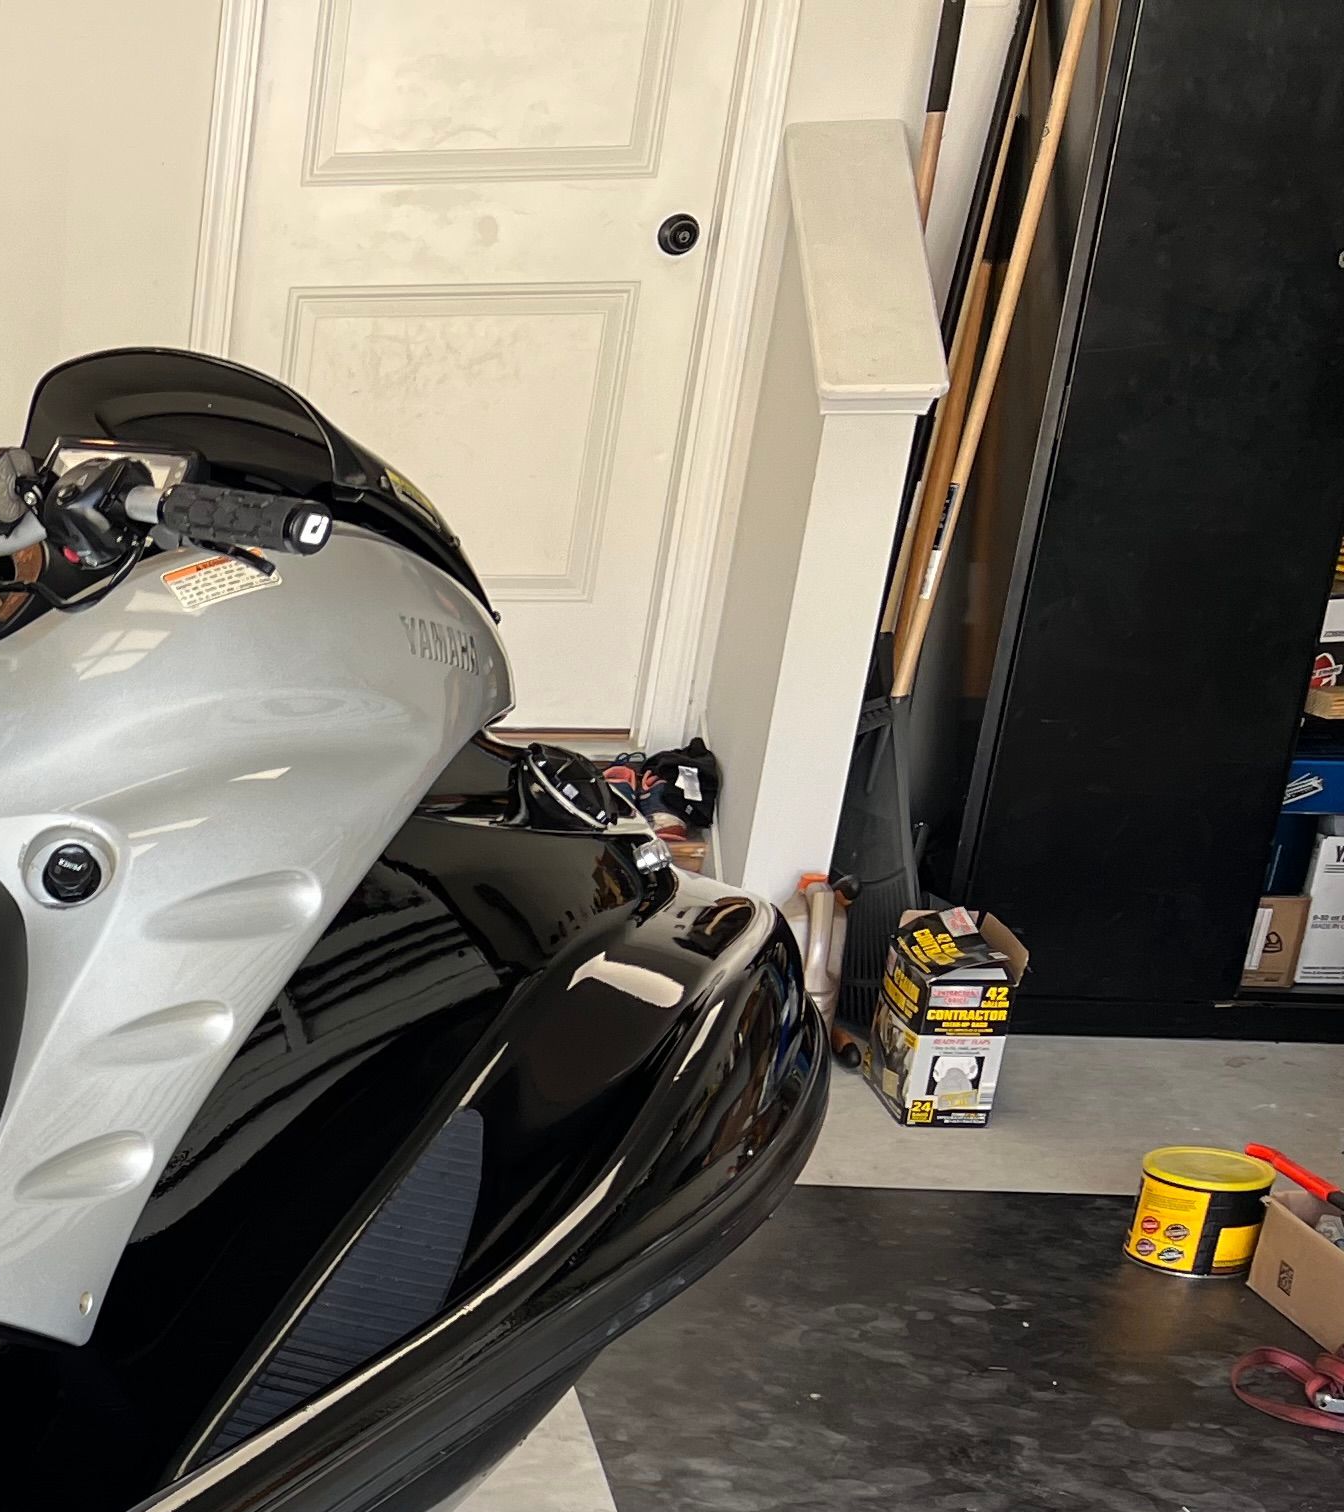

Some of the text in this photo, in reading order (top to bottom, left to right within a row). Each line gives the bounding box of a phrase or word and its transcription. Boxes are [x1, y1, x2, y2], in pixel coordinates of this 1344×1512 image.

[398, 613, 480, 676] YAMAHA
[985, 986, 1009, 1001] 42
[926, 1009, 1008, 1021] CONTRACTOR
[913, 1101, 931, 1112] 24
